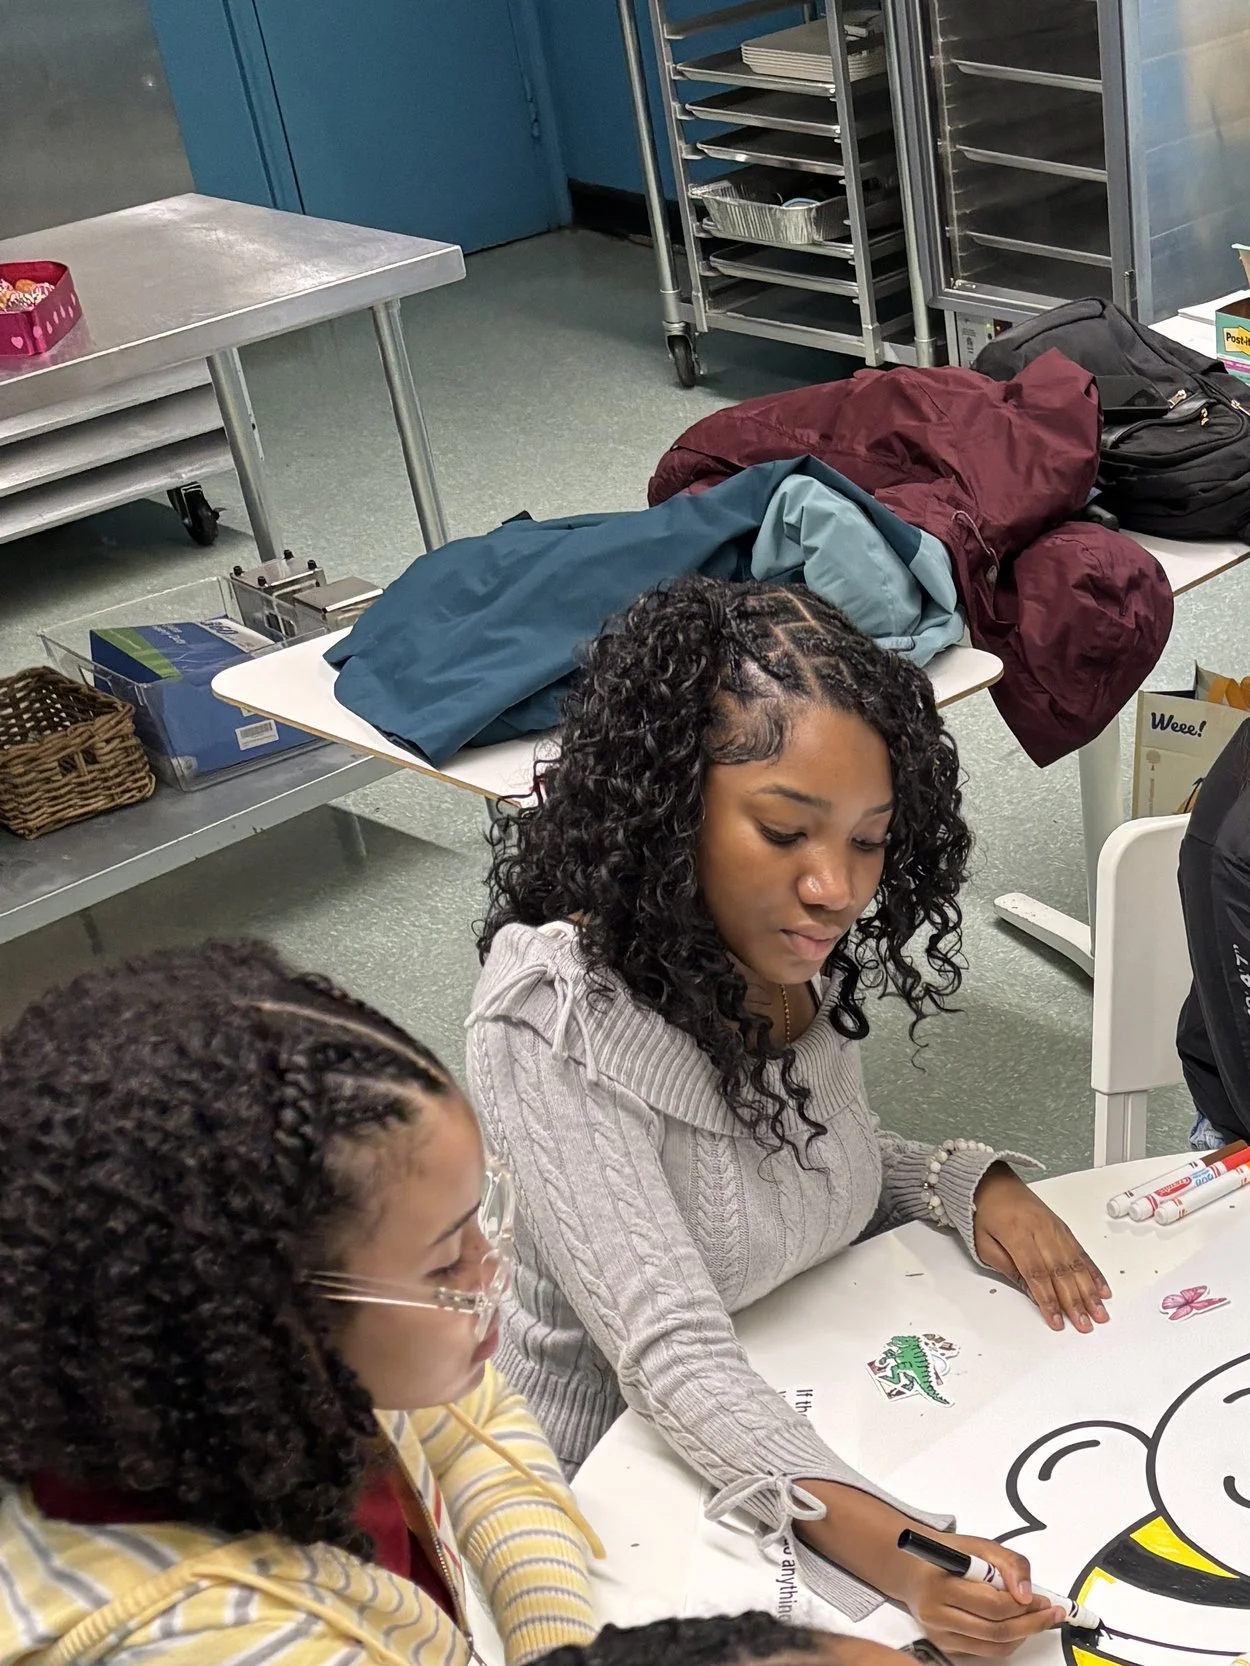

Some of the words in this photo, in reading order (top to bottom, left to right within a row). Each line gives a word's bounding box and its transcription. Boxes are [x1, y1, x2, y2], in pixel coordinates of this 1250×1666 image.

[1226, 332, 1250, 347] Post-it
[1151, 712, 1207, 737] Weee!
[796, 1389, 813, 1397] If
[795, 1401, 812, 1417] th
